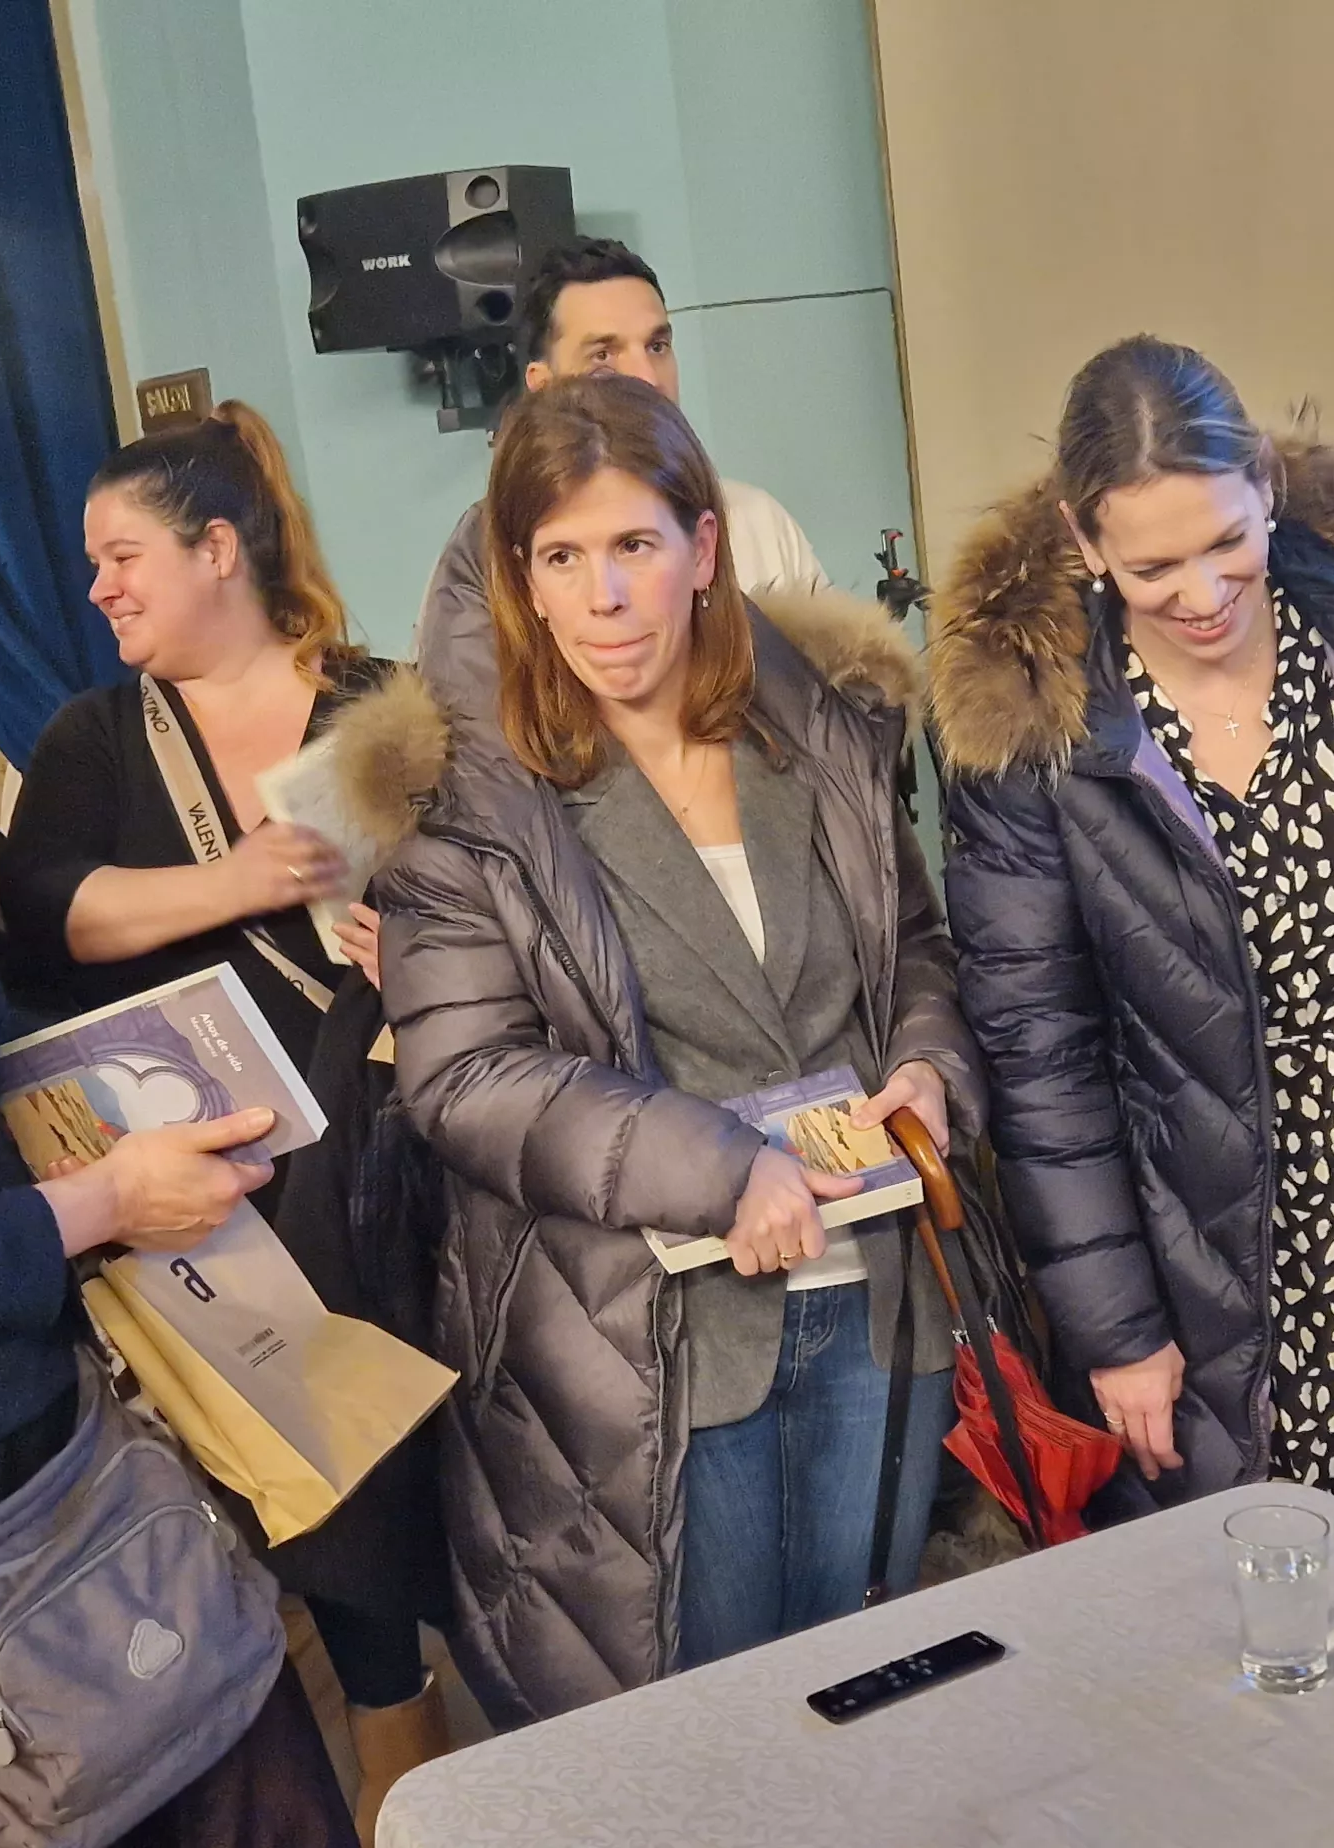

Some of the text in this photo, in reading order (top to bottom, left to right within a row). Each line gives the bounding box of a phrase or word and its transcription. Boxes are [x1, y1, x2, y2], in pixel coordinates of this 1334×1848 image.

[361, 254, 411, 271] WORK
[188, 801, 223, 862] VALENT
[199, 1013, 243, 1072] Años de vida
[169, 1257, 217, 1303] a
